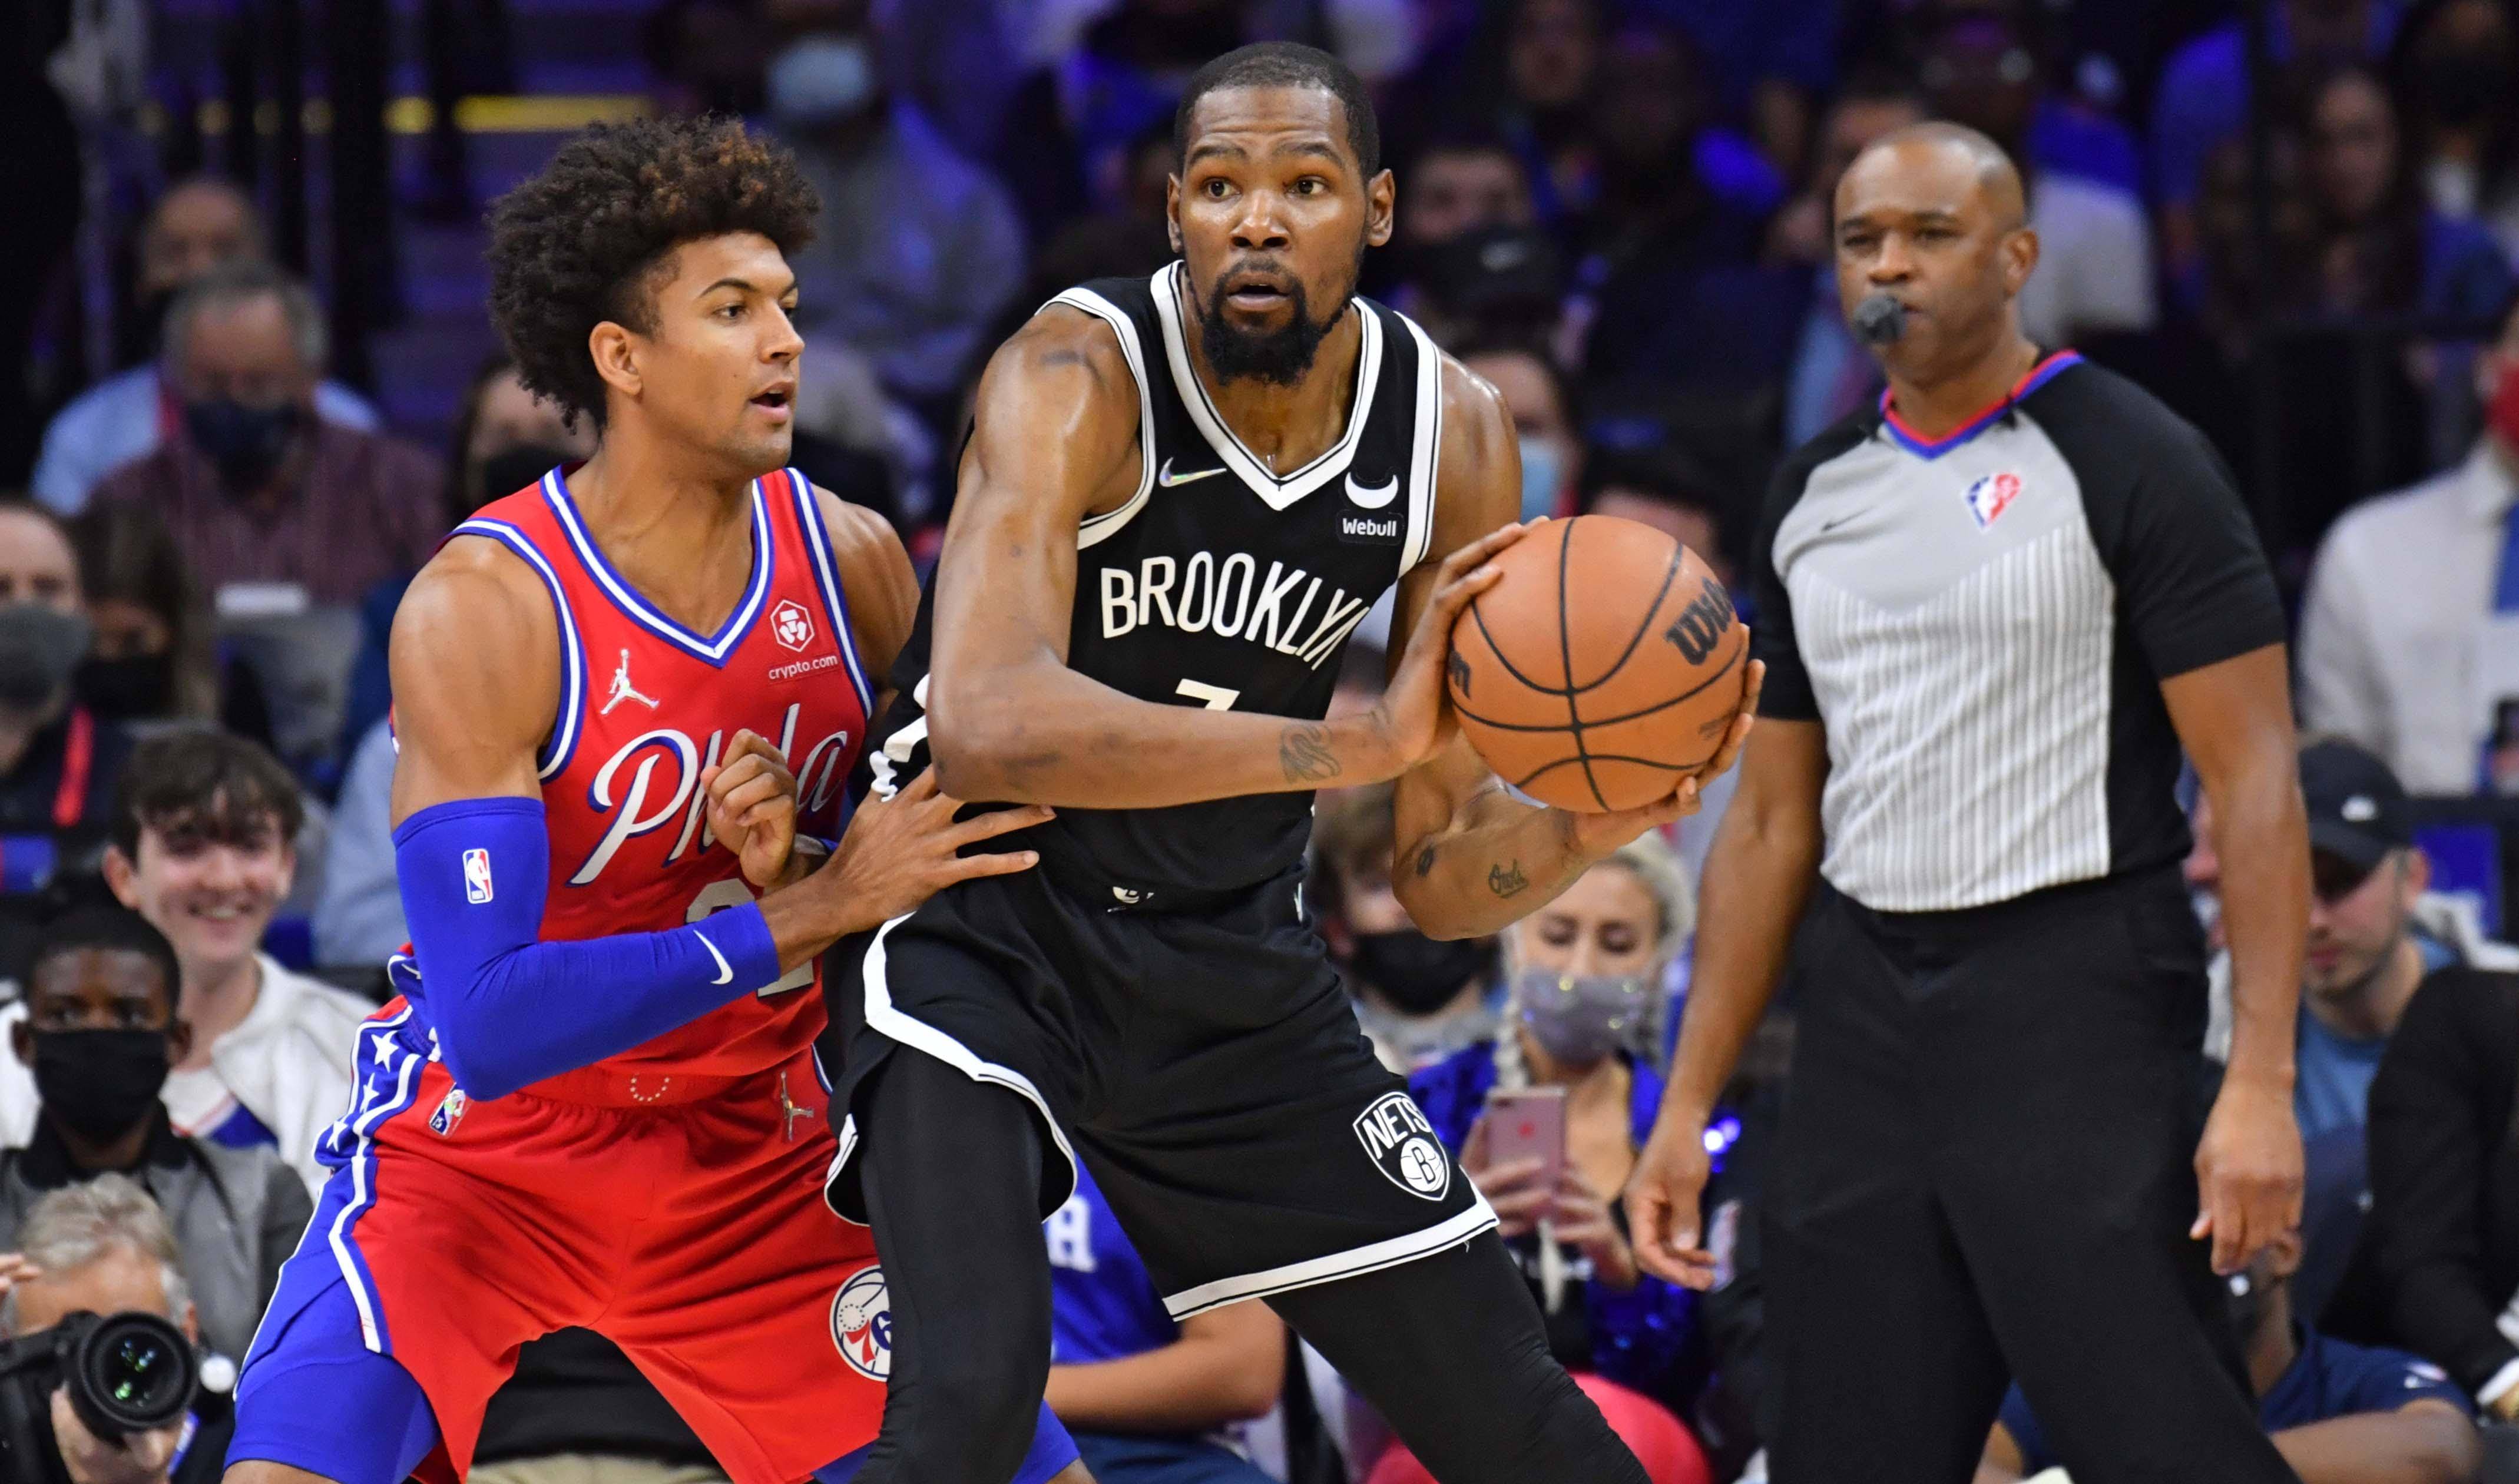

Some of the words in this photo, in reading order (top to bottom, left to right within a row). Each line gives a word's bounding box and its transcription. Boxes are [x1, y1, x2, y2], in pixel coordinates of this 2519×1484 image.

[1343, 518, 1396, 536] Webull
[768, 655, 838, 680] crypto.com
[1362, 1097, 1432, 1160] NETS
[1411, 1145, 1436, 1185] B
